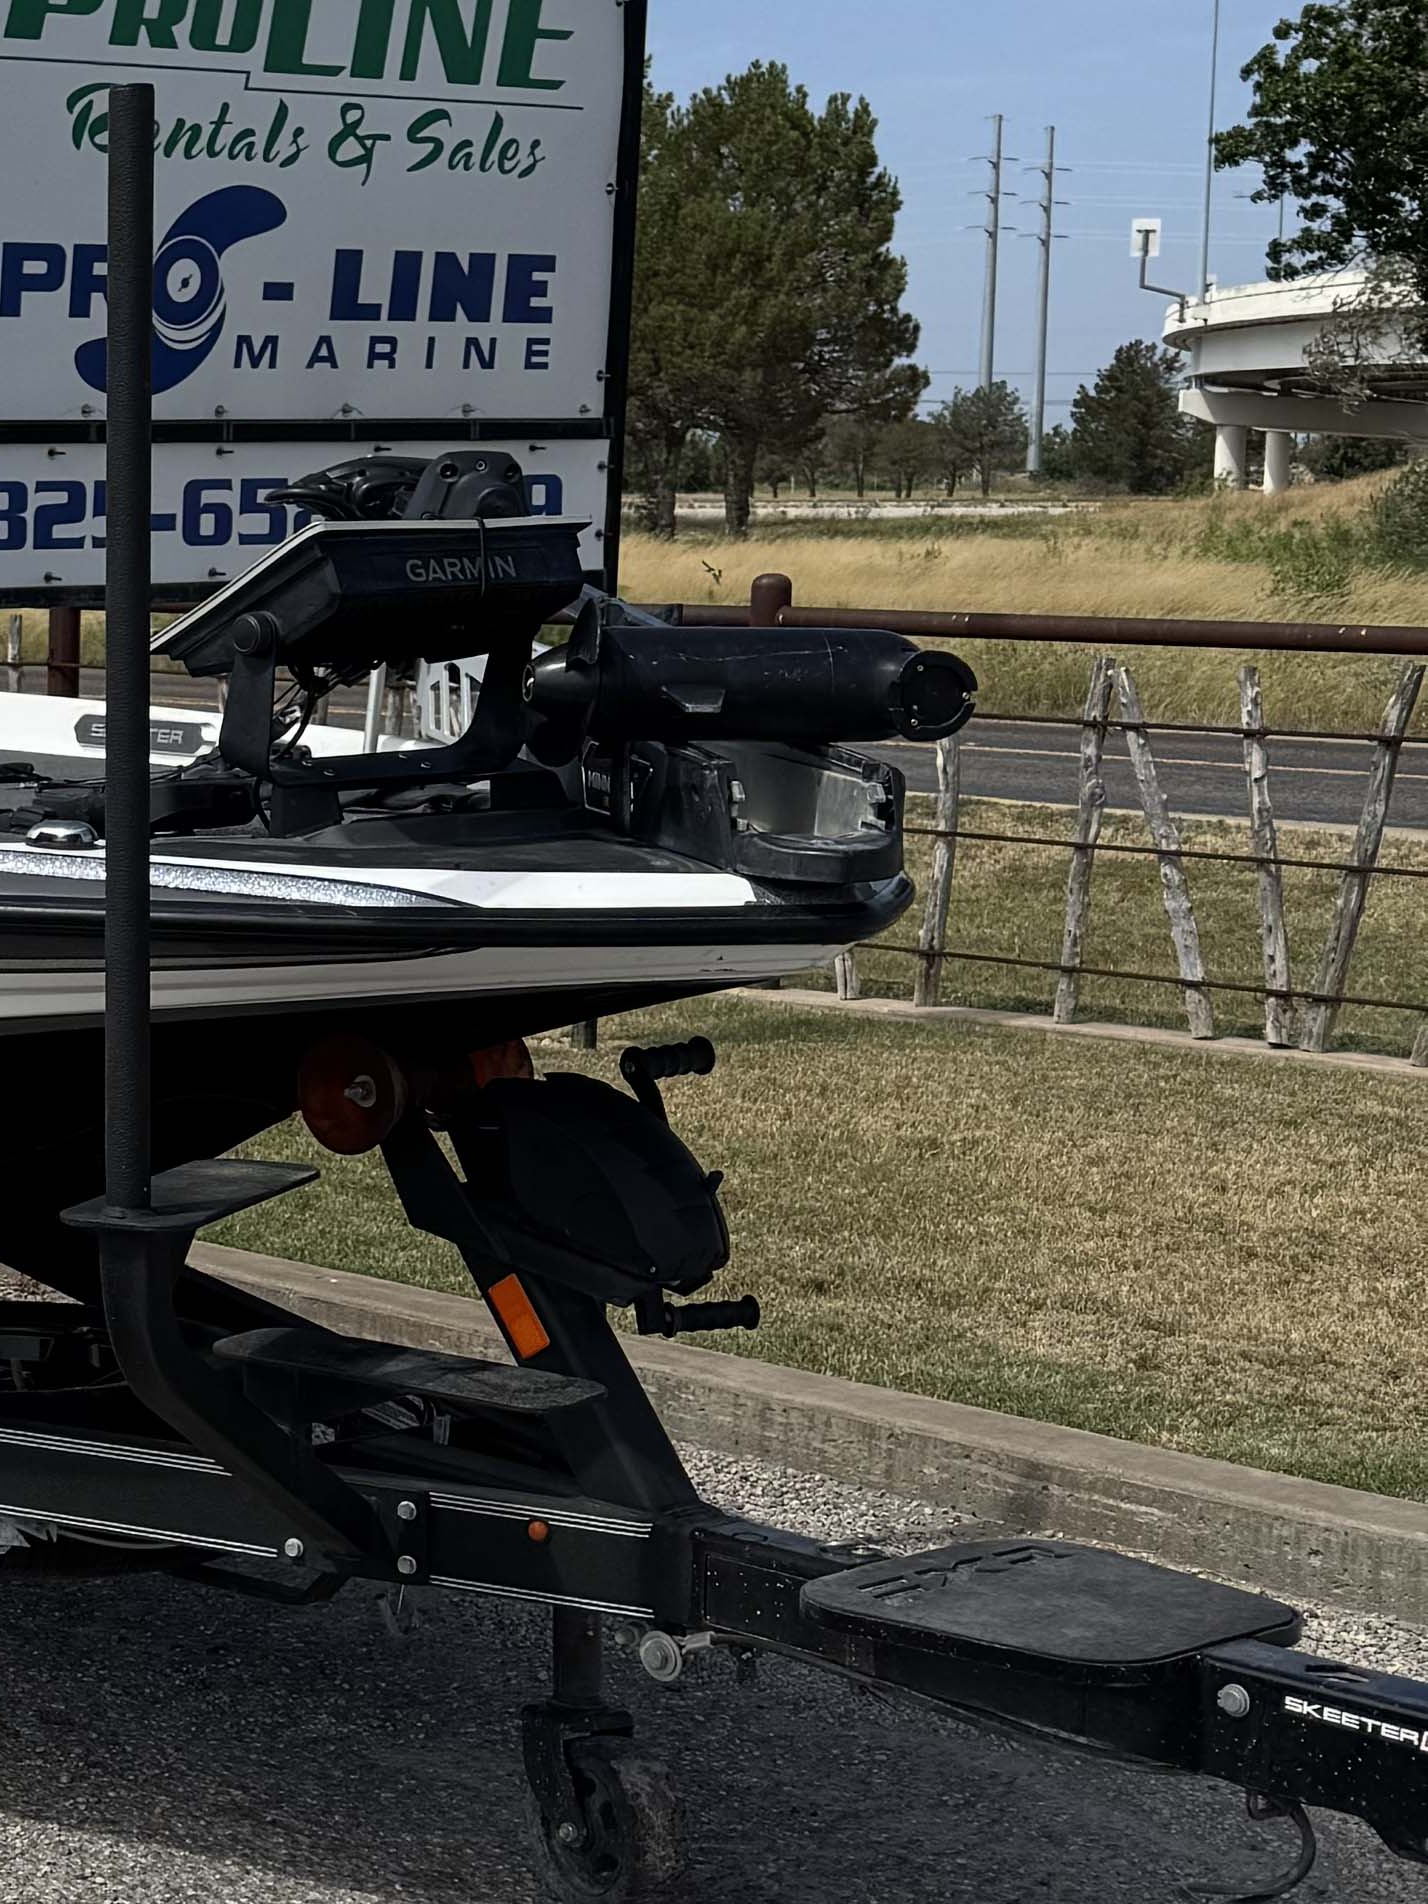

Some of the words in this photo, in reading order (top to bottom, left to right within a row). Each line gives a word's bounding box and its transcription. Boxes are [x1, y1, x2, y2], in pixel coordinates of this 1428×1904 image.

[65, 81, 311, 168] Rntals
[328, 102, 391, 186] &
[406, 108, 547, 179] Sales
[328, 248, 557, 325] LINE
[233, 334, 552, 371] MARINE
[405, 554, 518, 583] GARMIN
[1284, 1695, 1420, 1748] SKEETER
